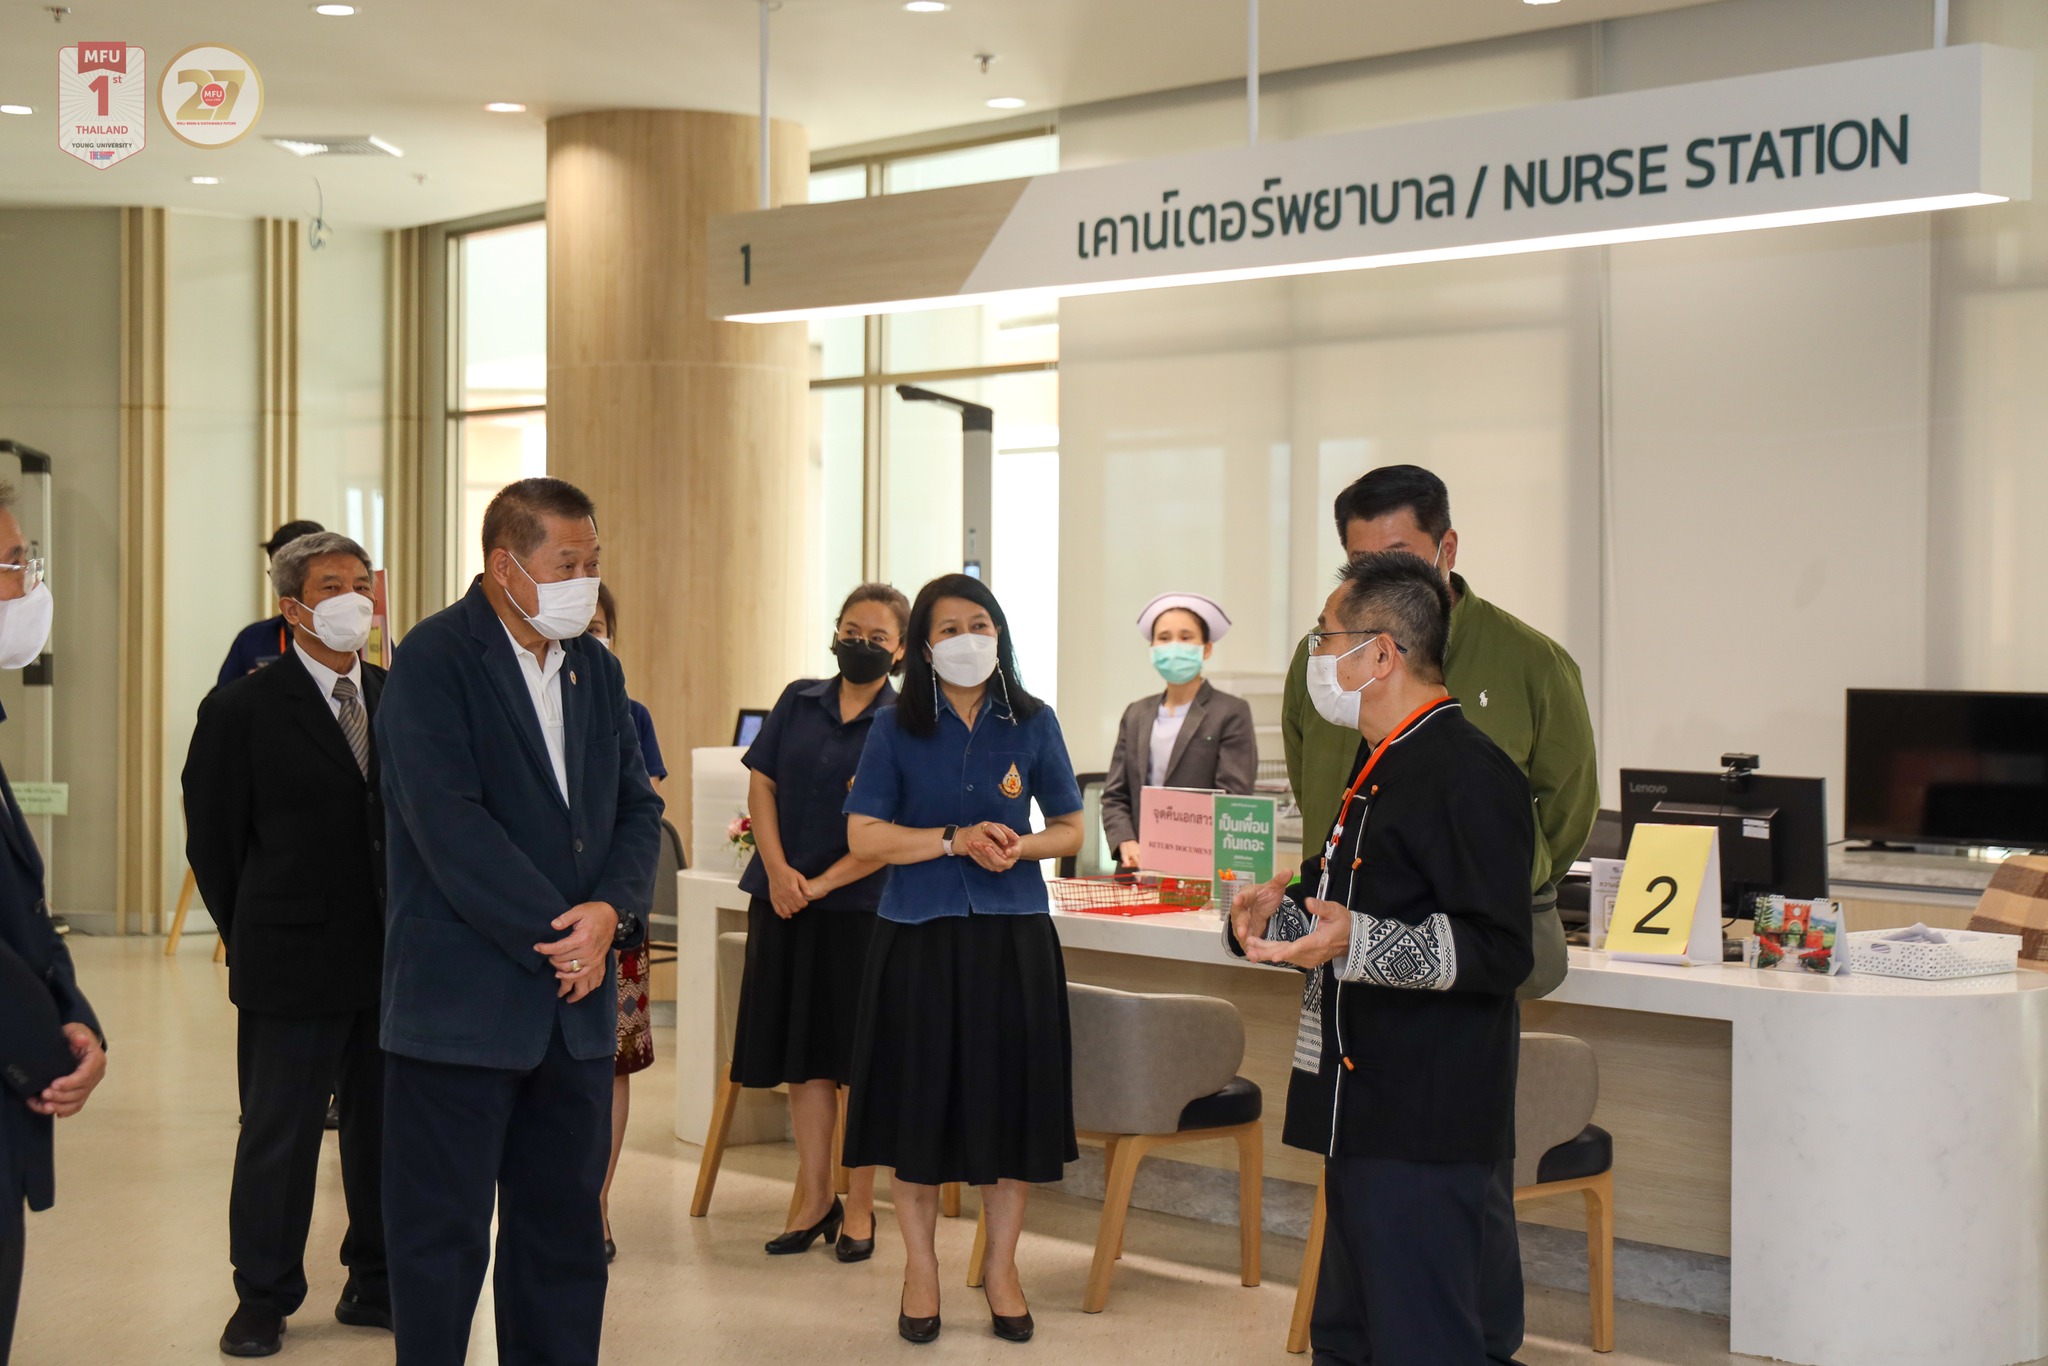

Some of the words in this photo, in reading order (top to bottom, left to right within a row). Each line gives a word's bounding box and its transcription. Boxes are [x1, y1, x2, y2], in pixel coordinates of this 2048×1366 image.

[1078, 172, 1455, 260] เคาน์เตอร์พยาบาล
[1465, 165, 1488, 219] /
[1504, 144, 1668, 211] NURSE
[1685, 113, 1909, 189] STATION
[740, 243, 751, 286] 1
[1629, 781, 1668, 794] Lenovo
[1219, 812, 1269, 834] เป็นเพื่อน
[1148, 841, 1174, 850] RETURN
[1632, 875, 1679, 935] 2
